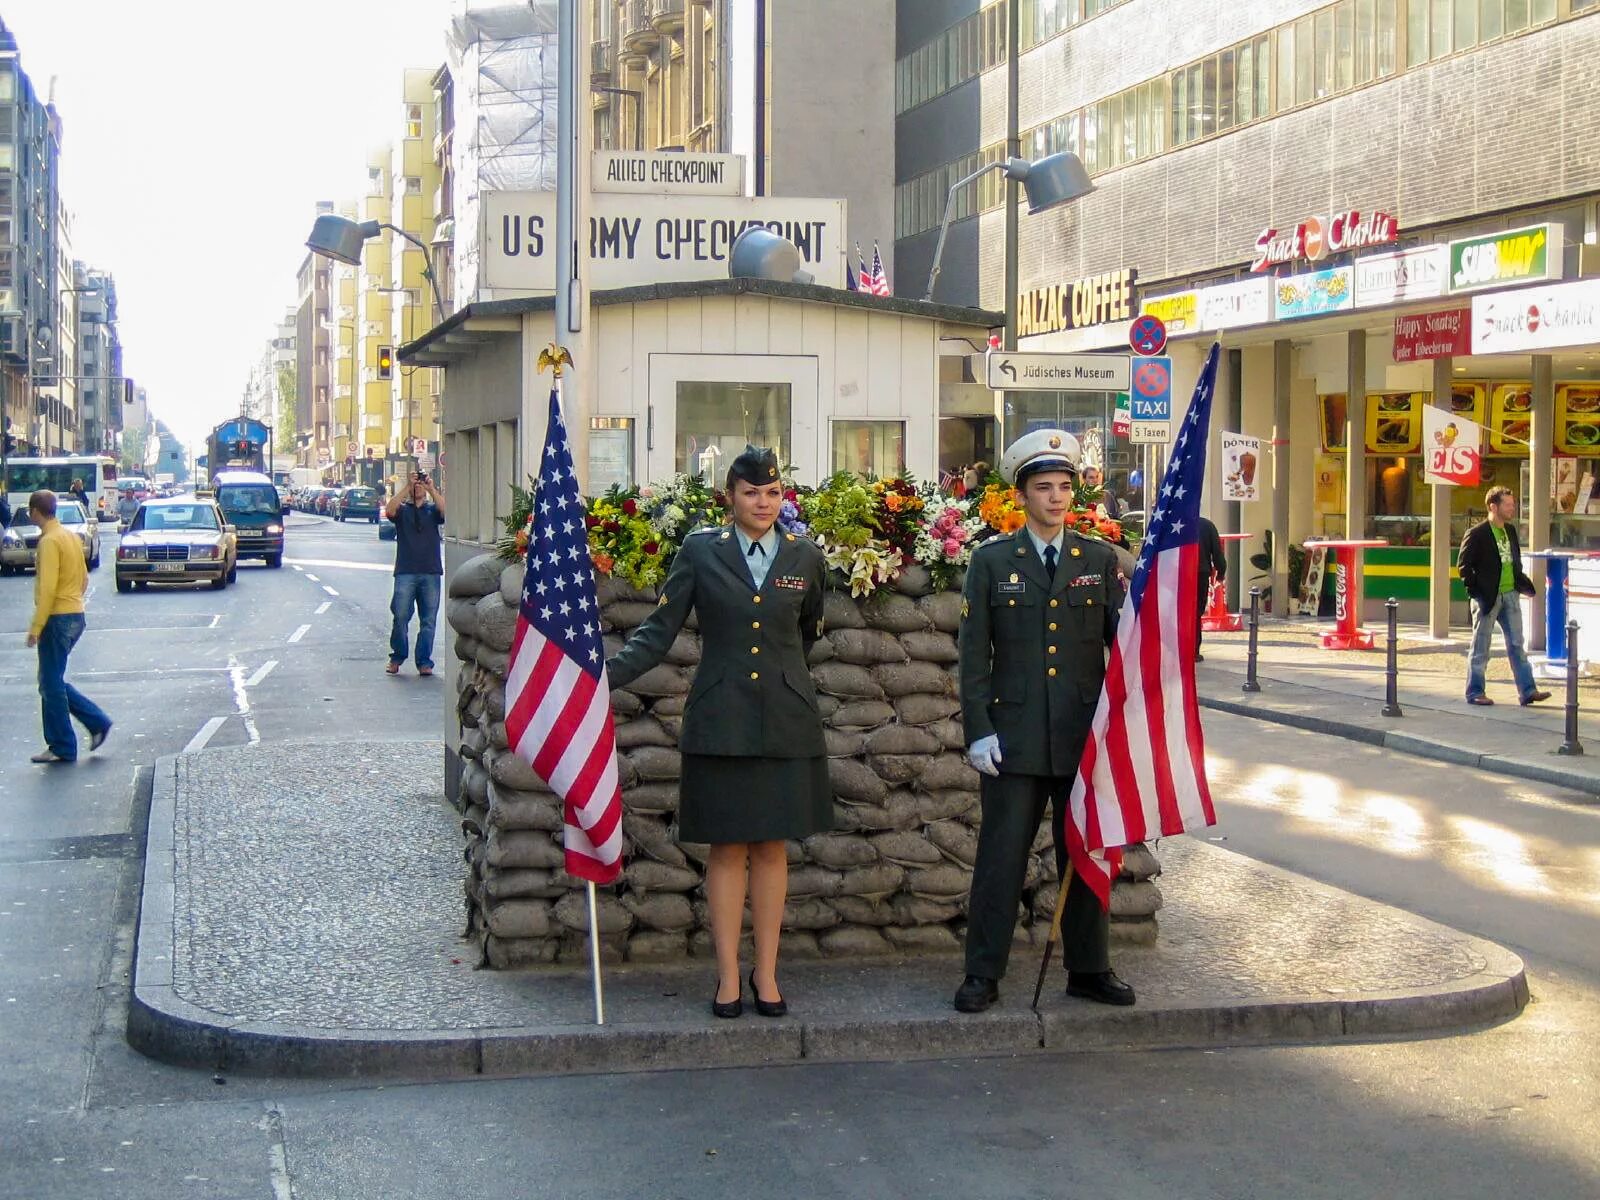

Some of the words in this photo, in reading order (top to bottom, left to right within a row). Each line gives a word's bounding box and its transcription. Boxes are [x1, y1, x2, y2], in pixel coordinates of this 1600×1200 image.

[607, 158, 646, 182] ALLIED
[651, 160, 725, 184] CHECKPOINT
[502, 214, 545, 257] US
[589, 216, 642, 260] RMY
[655, 218, 827, 263] CHECKNT
[1250, 224, 1304, 272] Snack
[1327, 209, 1395, 250] Charlie
[1454, 230, 1545, 287] SUBWAY
[1072, 269, 1136, 328] COFFEE
[1396, 317, 1421, 339] Happy
[1023, 365, 1071, 379] Jüdisches
[1074, 367, 1115, 379] Museum
[1135, 401, 1167, 415] TAXI
[1135, 426, 1140, 437] 5
[1143, 426, 1166, 437] Taxen
[1223, 438, 1259, 449] DÖNER
[1426, 447, 1474, 474] EIS
